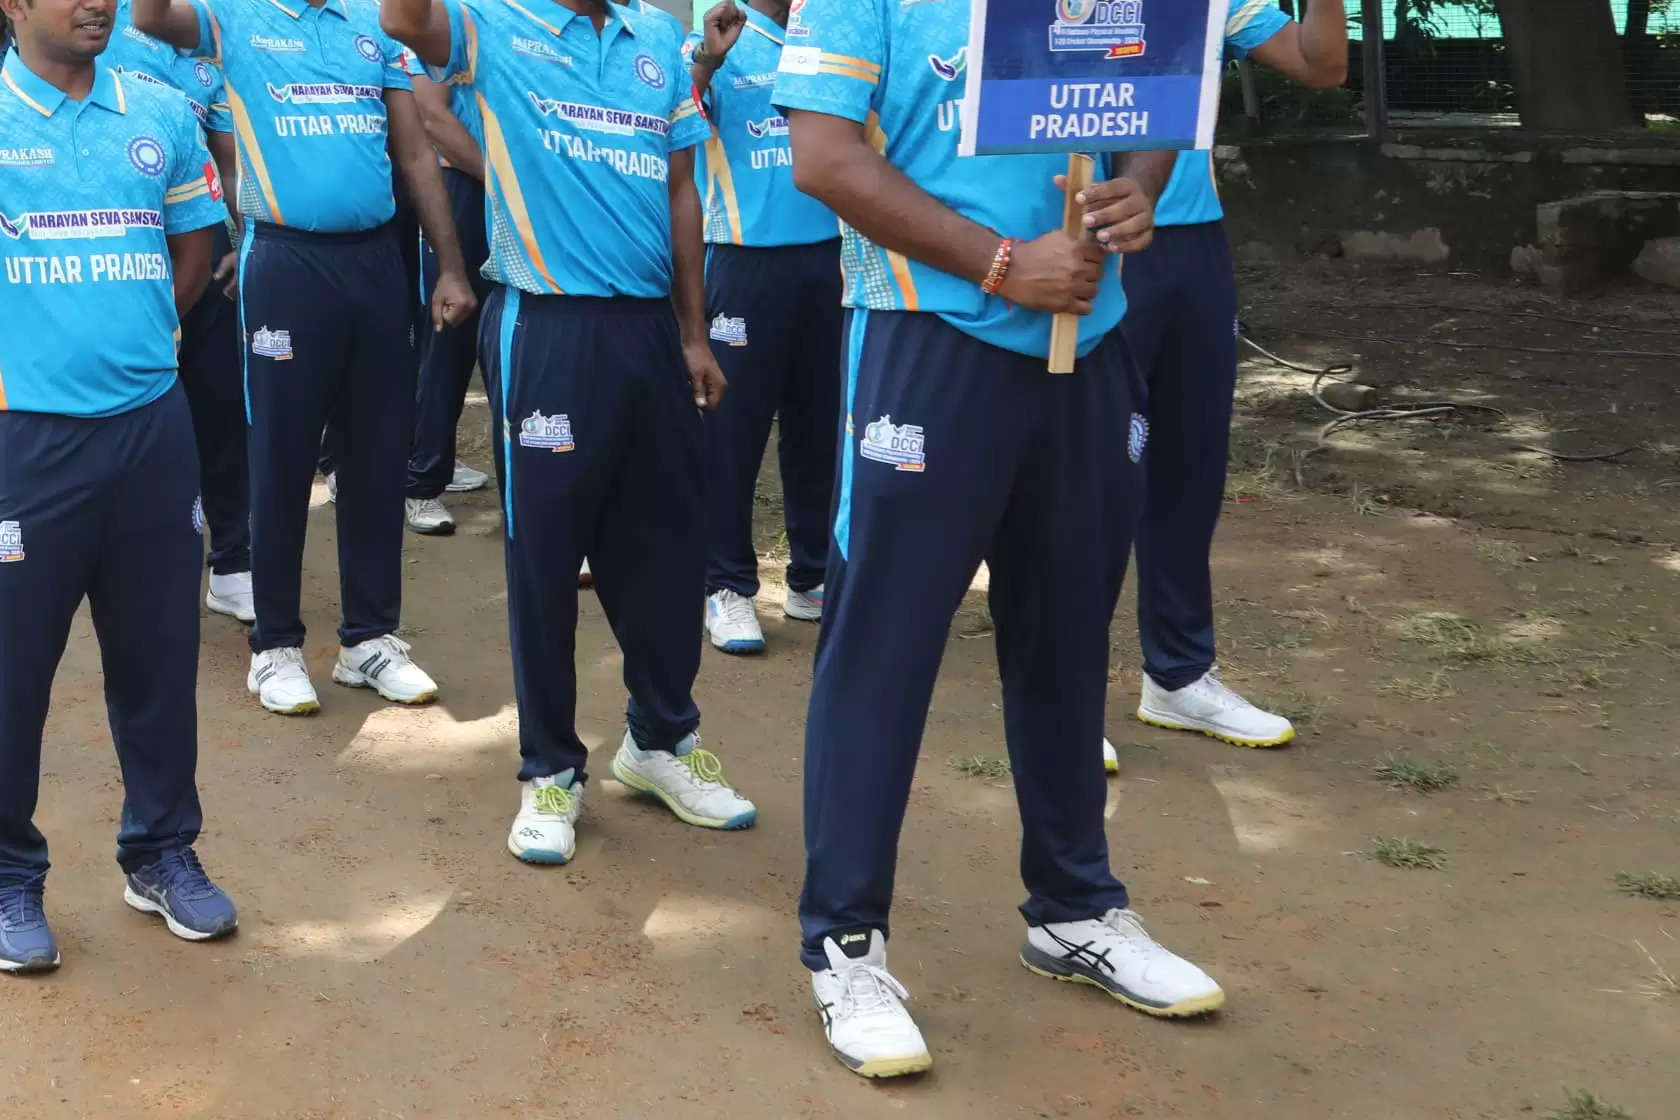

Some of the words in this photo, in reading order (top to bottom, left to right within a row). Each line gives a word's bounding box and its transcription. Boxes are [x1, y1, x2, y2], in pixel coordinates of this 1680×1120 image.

[1096, 1, 1142, 24] DCCI
[1050, 83, 1135, 109] UTTAR
[274, 115, 333, 137] UTTAR
[606, 111, 632, 126] SEVA
[1029, 111, 1148, 139] PRADESH
[751, 147, 792, 169] UTTA
[29, 213, 88, 229] NARAYAN
[91, 211, 121, 228] SEVA
[5, 256, 83, 283] UTTAR
[545, 426, 571, 436] DCCI
[891, 436, 923, 452] DCCI
